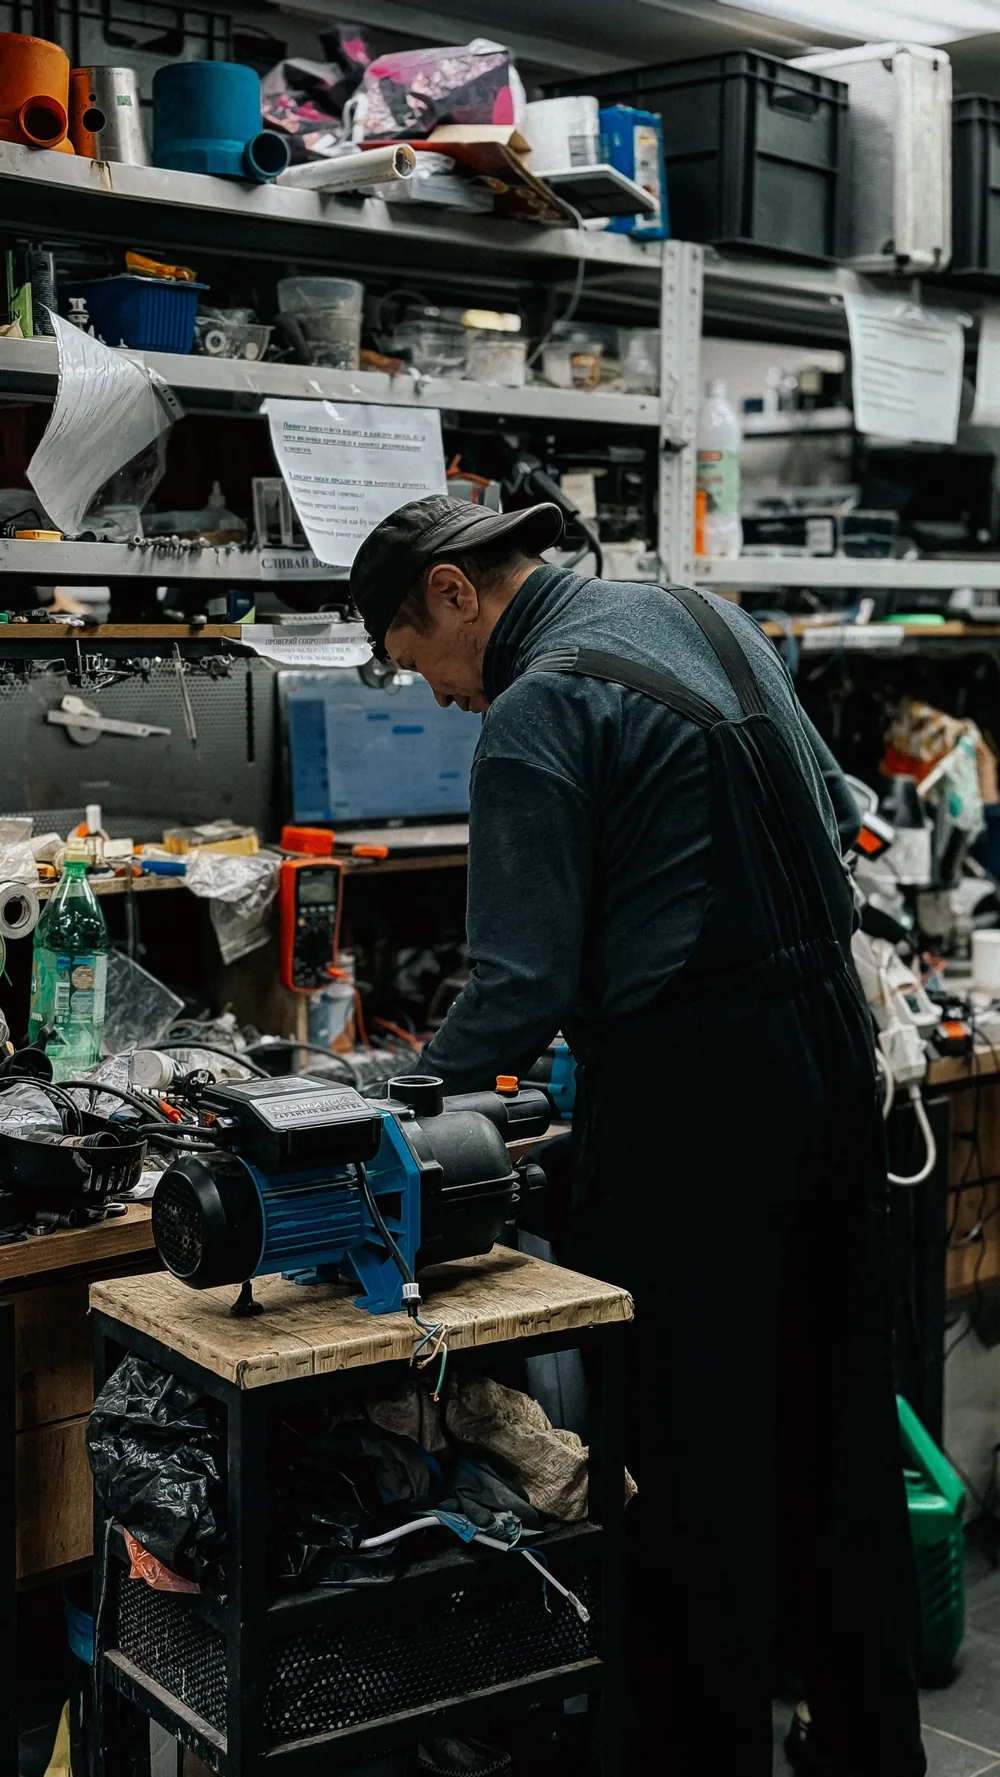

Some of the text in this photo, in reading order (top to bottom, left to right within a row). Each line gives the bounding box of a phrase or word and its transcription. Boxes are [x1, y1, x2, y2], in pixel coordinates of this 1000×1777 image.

[262, 556, 309, 569] СЛИВАЙ
[265, 637, 298, 645] ПРОВЕРЯЙ
[274, 1102, 363, 1119] ГАРАНТИЯ КАЧЕСТВА
